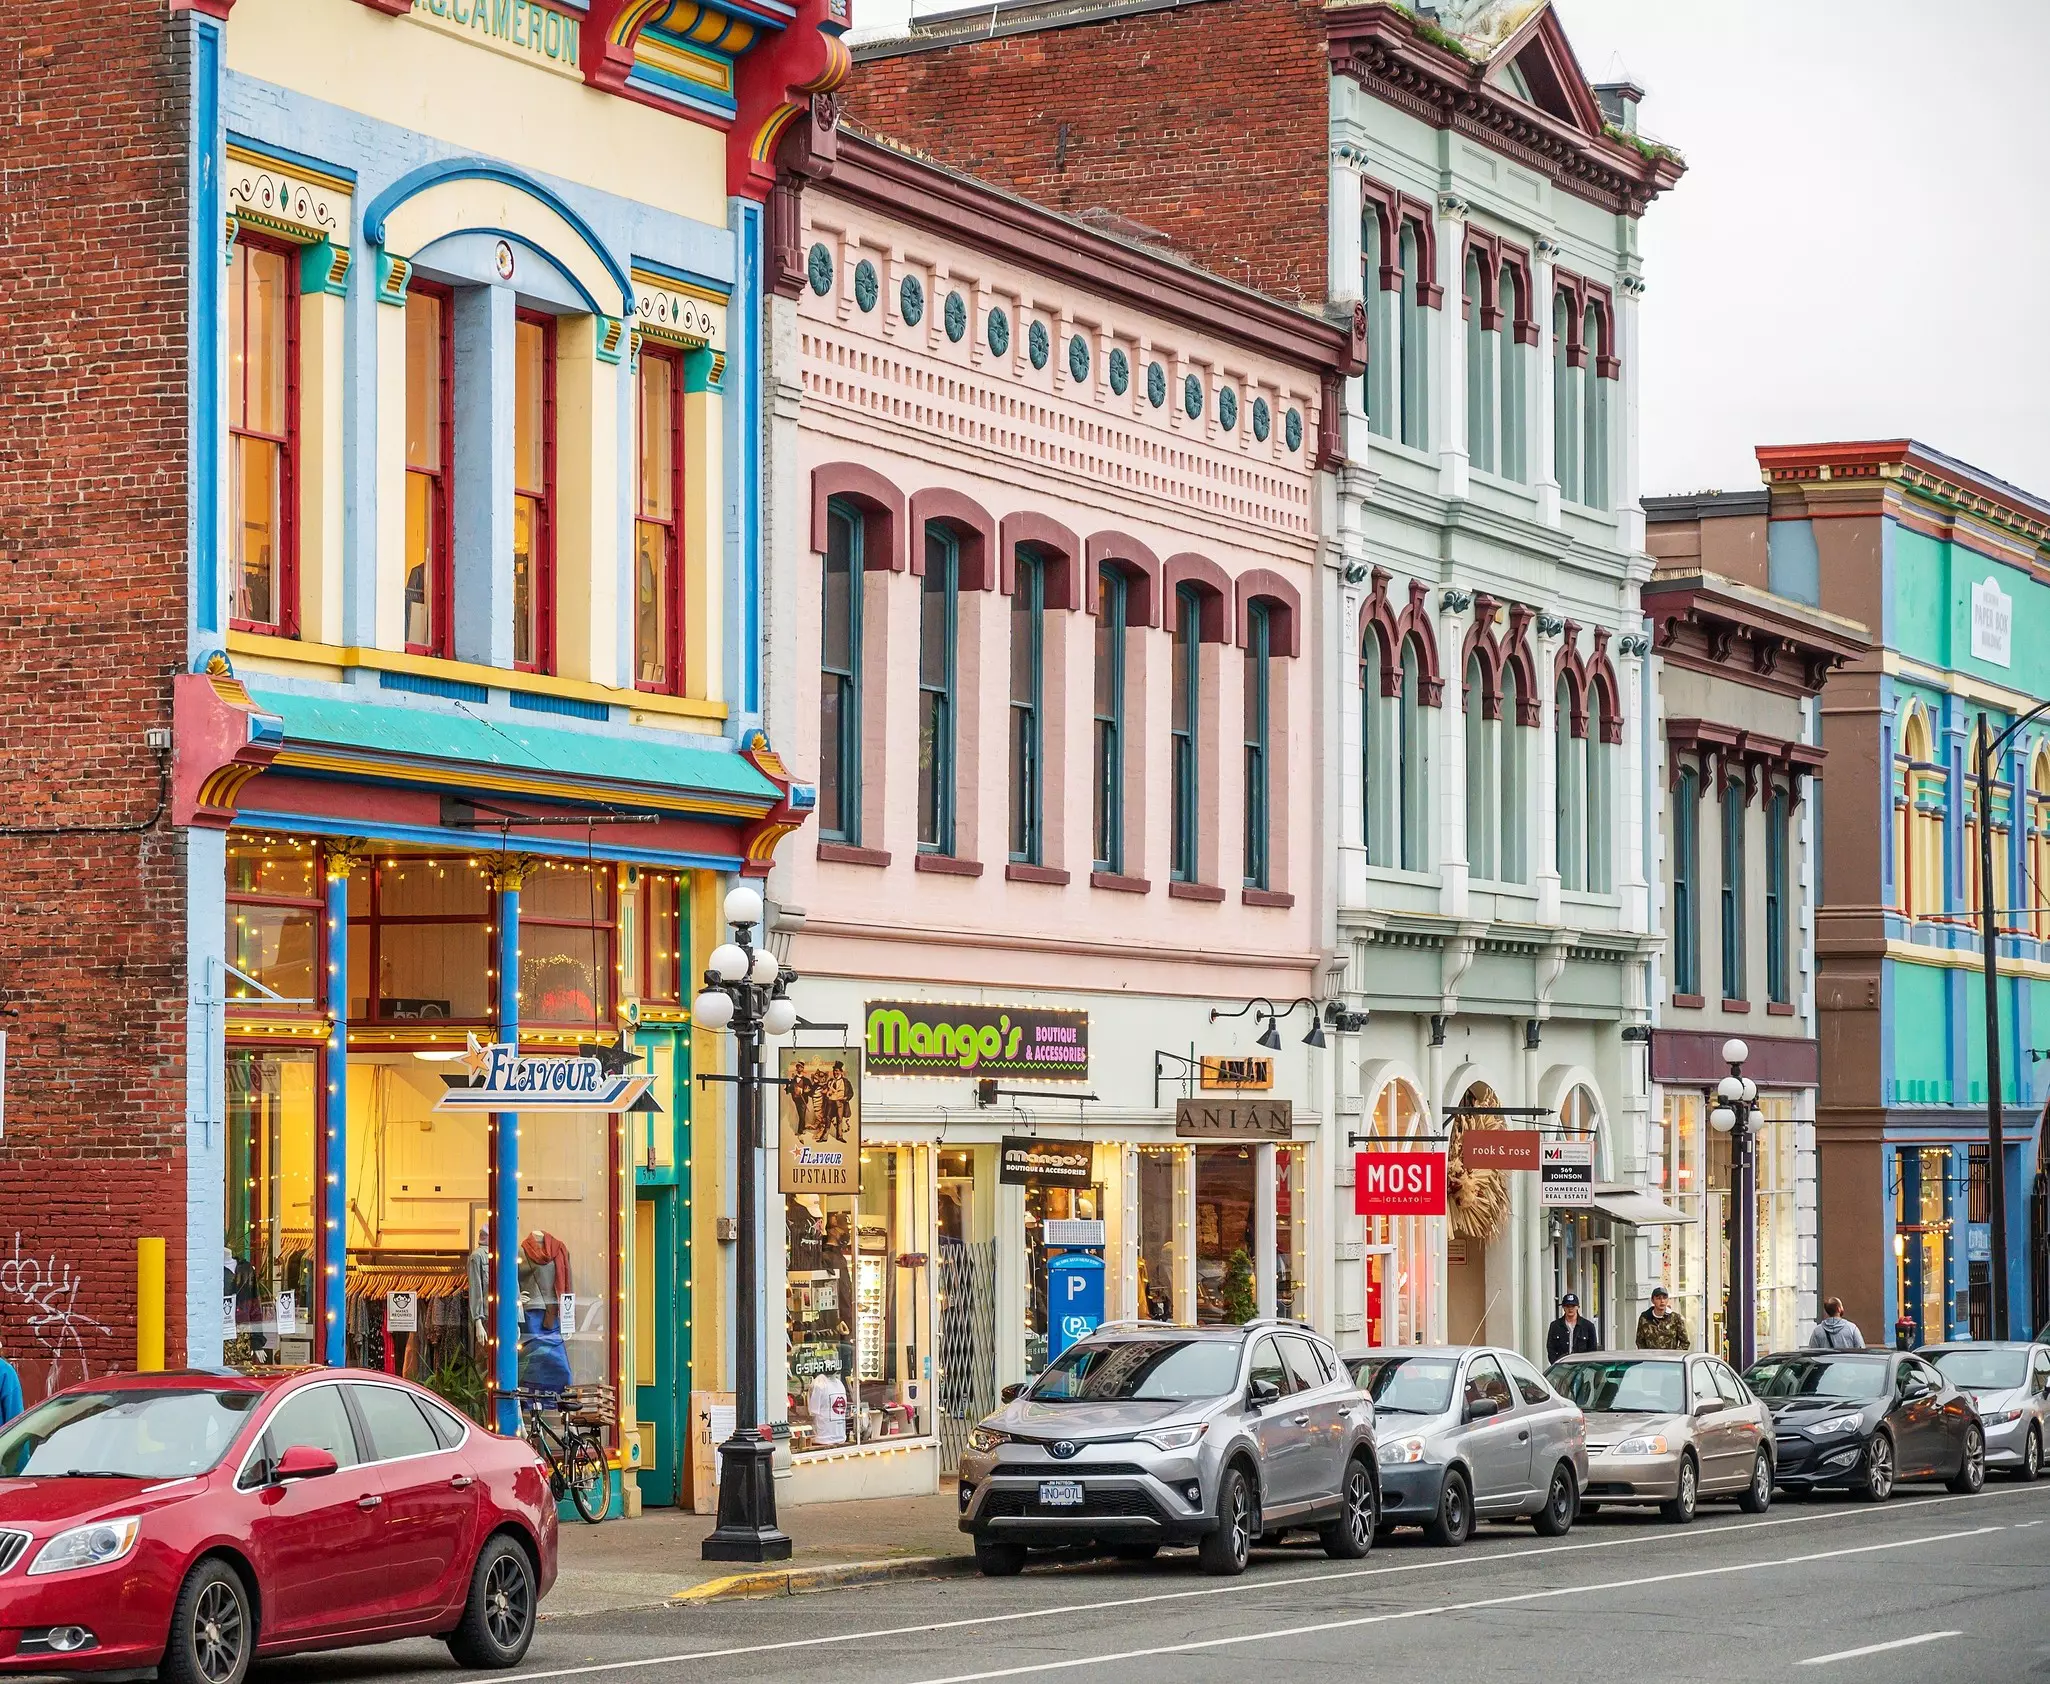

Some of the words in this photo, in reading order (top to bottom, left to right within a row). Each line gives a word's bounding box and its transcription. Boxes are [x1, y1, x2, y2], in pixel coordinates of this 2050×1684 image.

[1975, 603, 1993, 628] PAPER
[1995, 611, 2009, 636] BOX
[867, 1008, 1022, 1069] Mango's
[1035, 1026, 1077, 1043] BOUTIQUE
[1025, 1044, 1033, 1061] &
[1034, 1044, 1086, 1063] ACCESSORIES
[1176, 1104, 1289, 1129] ANIÁN
[1005, 1149, 1089, 1168] Mango's
[1472, 1145, 1496, 1155] rook
[1498, 1145, 1506, 1155] &
[1508, 1147, 1531, 1156] rose
[1544, 1148, 1562, 1159] NAI
[792, 1168, 847, 1184] UPSTAIRS
[1006, 1164, 1039, 1173] BOUTIQUE
[1045, 1167, 1087, 1176] ACCESSORIES
[1368, 1164, 1432, 1193] MOSI
[1067, 1275, 1087, 1301] P
